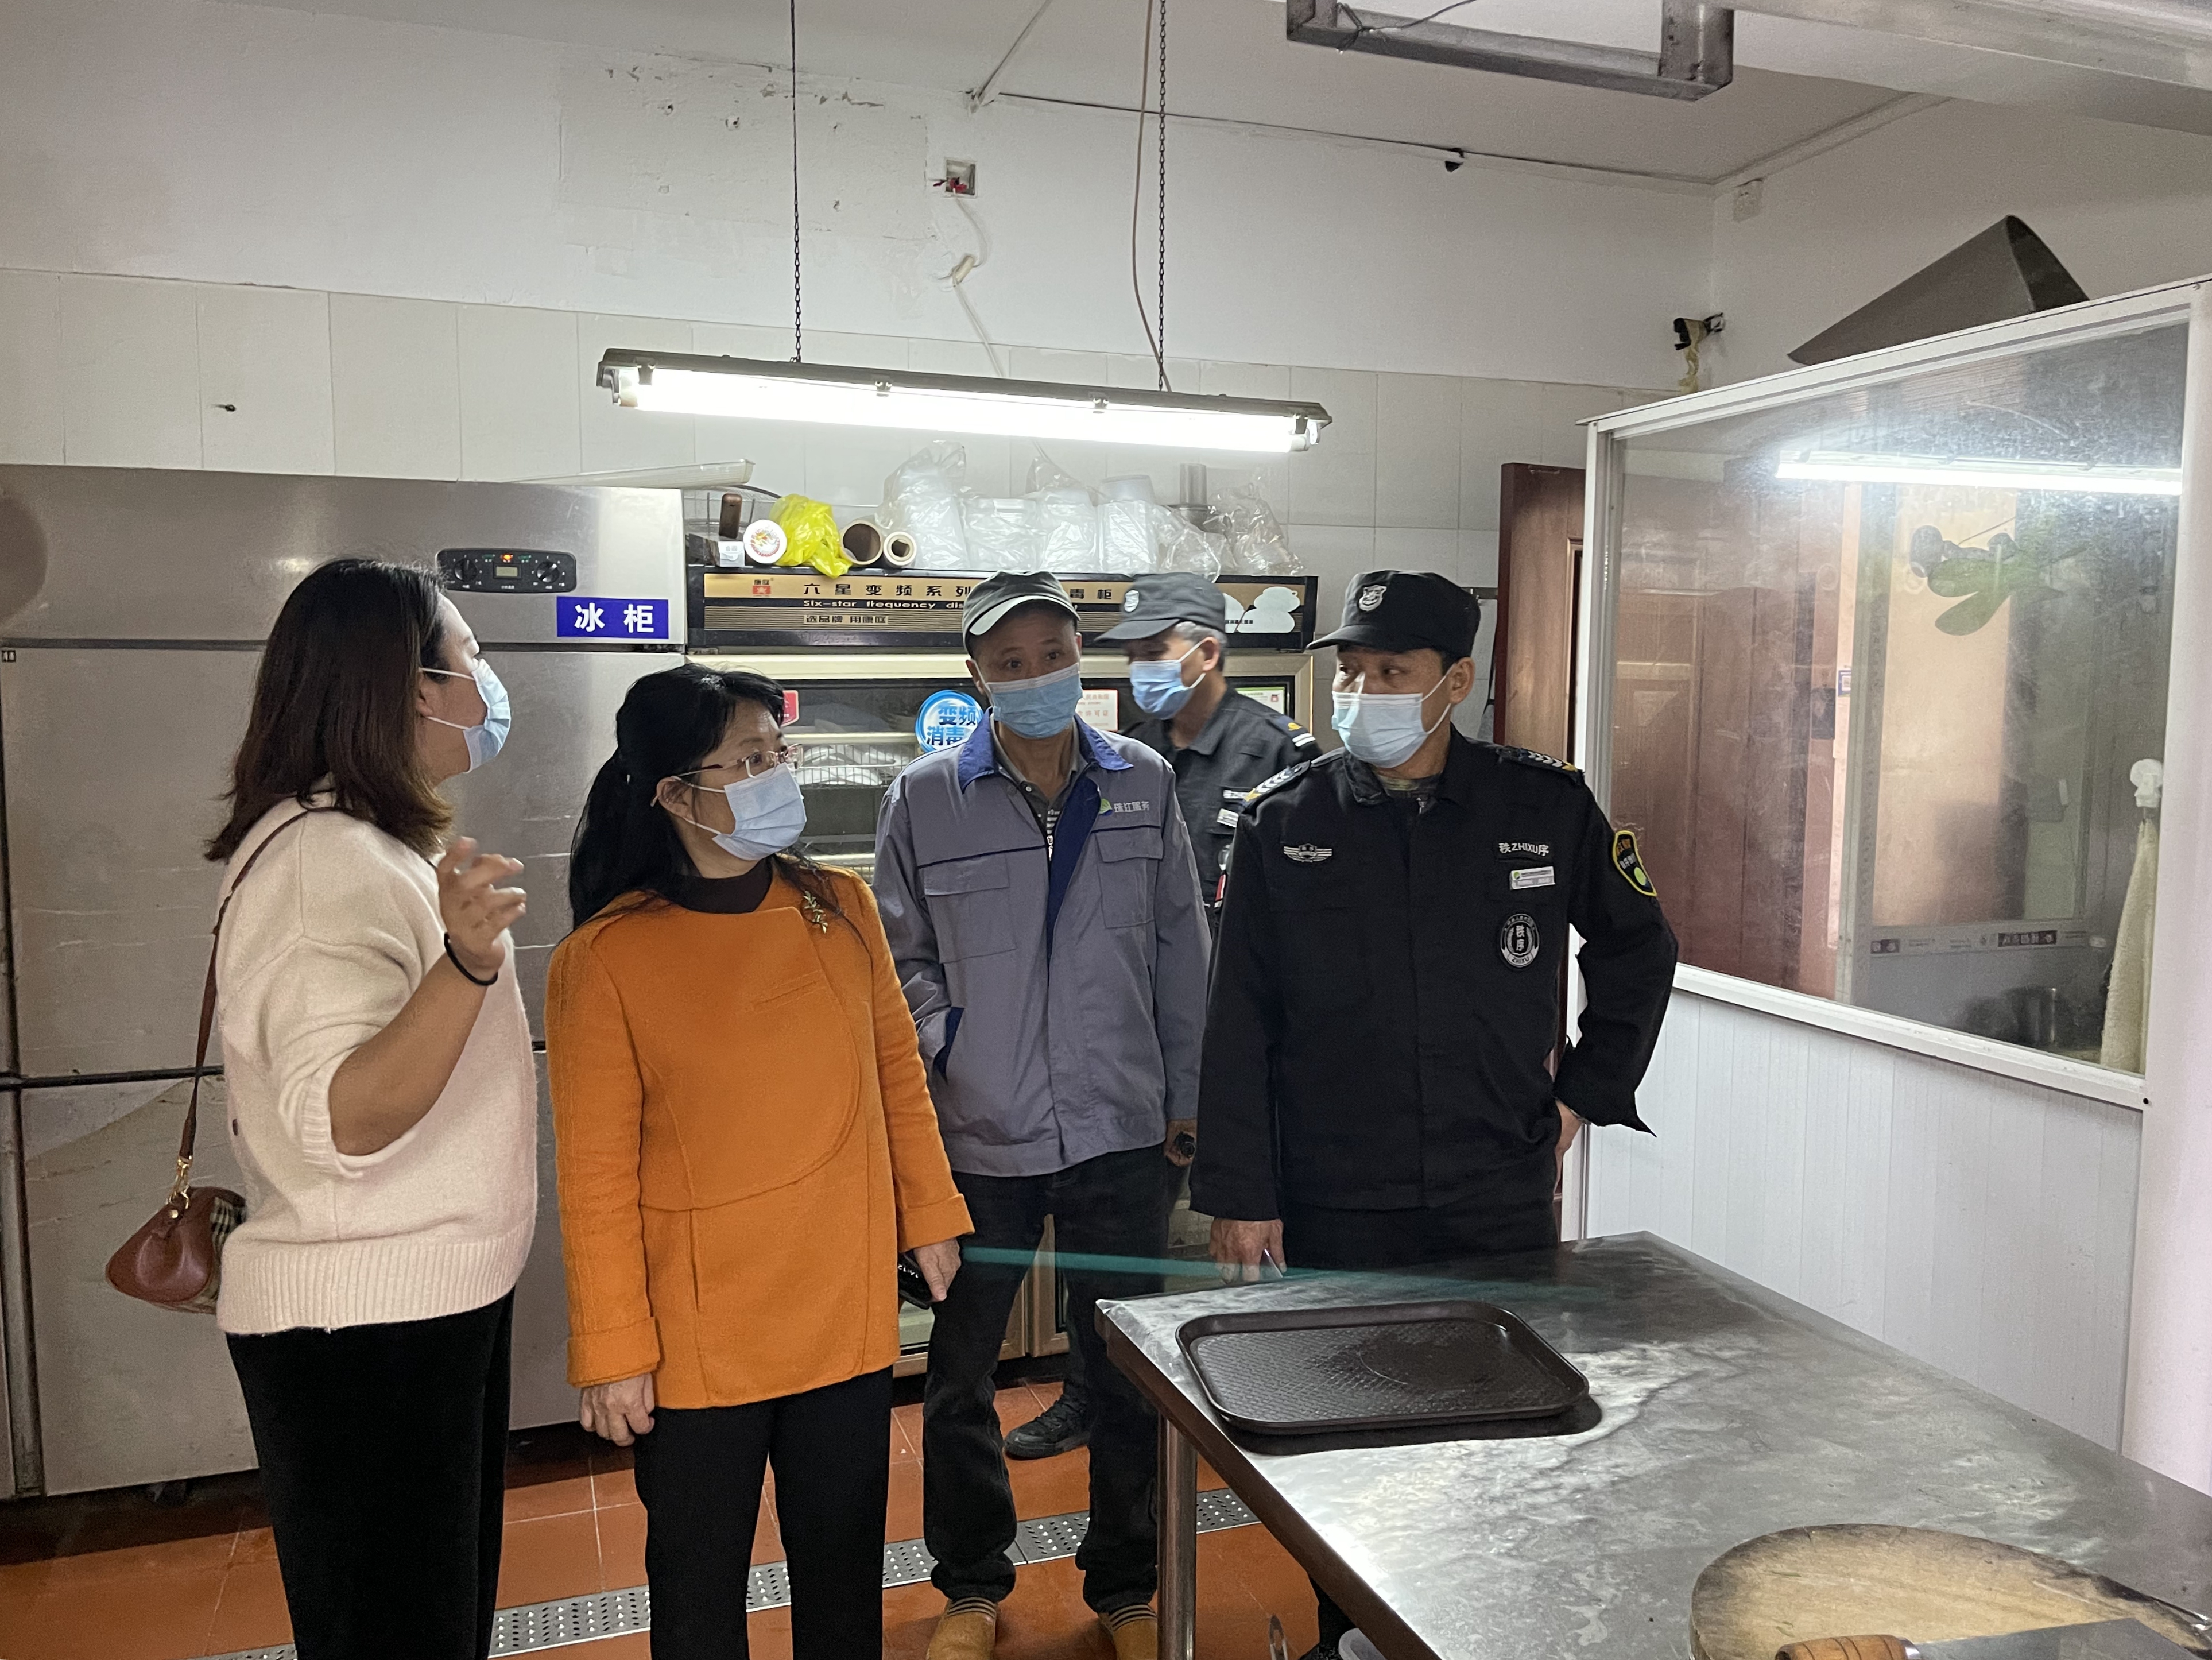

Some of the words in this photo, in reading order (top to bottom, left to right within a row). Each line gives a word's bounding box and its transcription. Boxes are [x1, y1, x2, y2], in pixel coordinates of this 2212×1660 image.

[803, 583, 971, 597] 六星变频系列
[866, 601, 936, 610] frequency
[574, 602, 654, 633] 冰柜
[805, 615, 843, 624] 选品牌
[938, 701, 977, 726] 变频
[927, 726, 965, 746] 消毒
